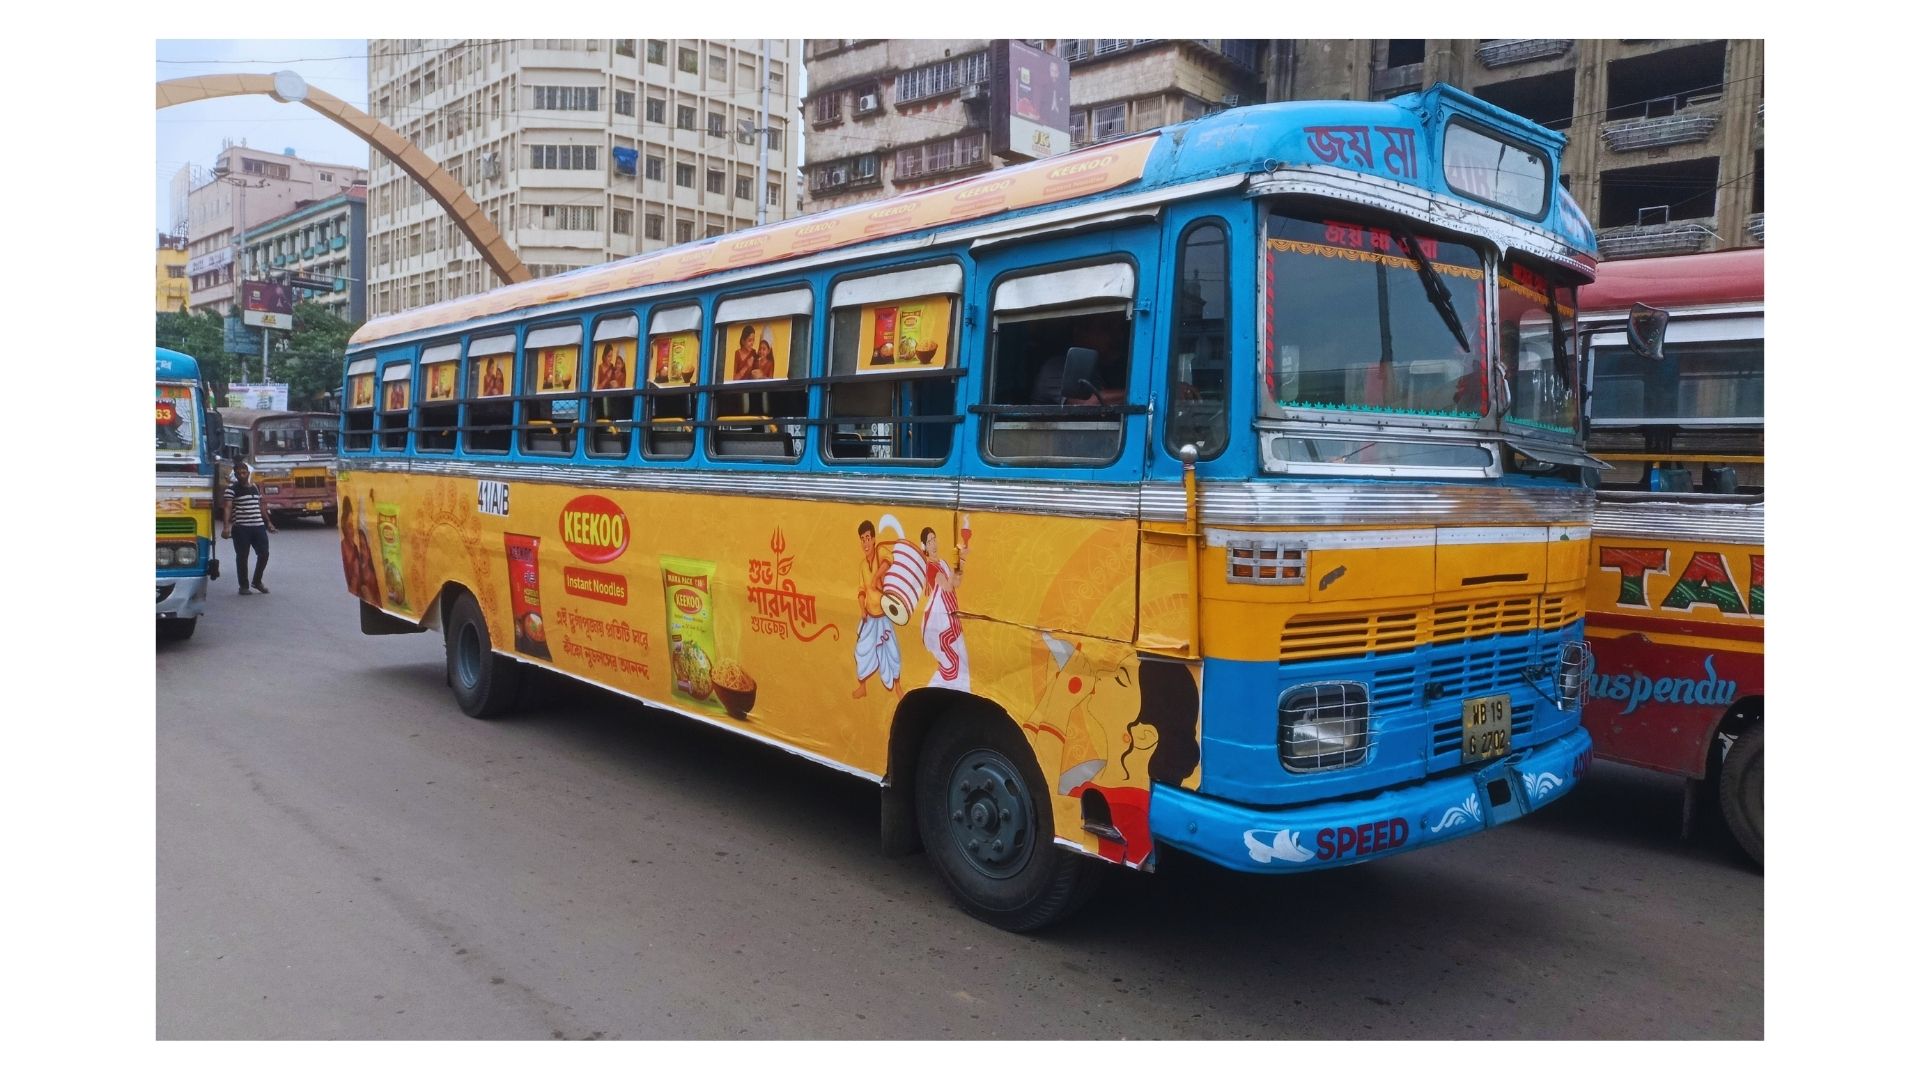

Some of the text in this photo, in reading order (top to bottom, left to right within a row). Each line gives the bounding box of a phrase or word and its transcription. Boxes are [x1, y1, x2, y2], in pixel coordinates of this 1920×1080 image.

[1050, 156, 1113, 178] KEEKOO
[1303, 125, 1418, 179] জয় মা
[957, 179, 1011, 200] KEEKOO
[477, 481, 510, 516] 41/A/B
[563, 511, 624, 549] KEEKOO
[566, 574, 625, 598] Instant Noodles
[748, 558, 774, 585] শুভ
[1599, 546, 1764, 619] TA
[675, 593, 700, 609] KEEKOO
[747, 579, 839, 642] শারদীয়া
[1587, 653, 1737, 715] uspendu
[1472, 701, 1503, 726] WB 19
[1481, 730, 1506, 754] 2702
[1316, 818, 1409, 861] SPEED
